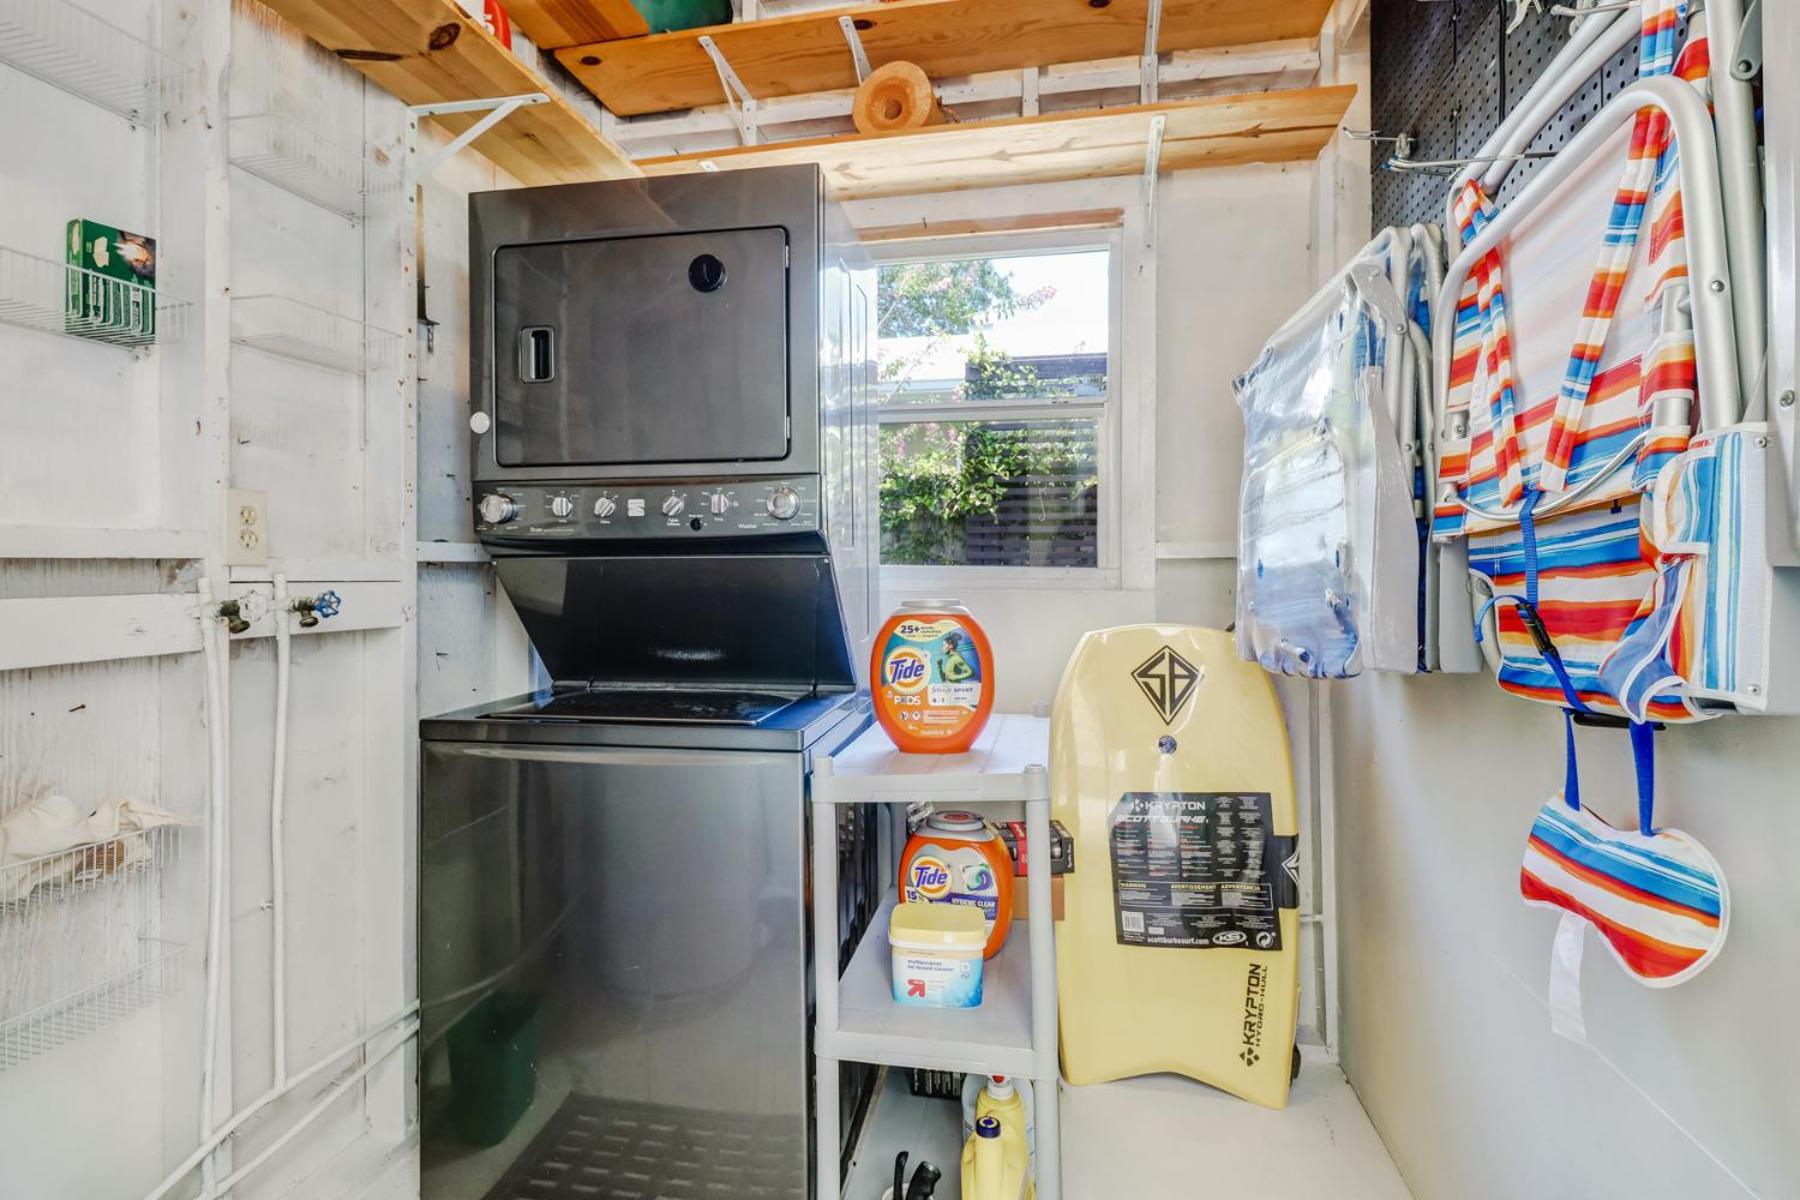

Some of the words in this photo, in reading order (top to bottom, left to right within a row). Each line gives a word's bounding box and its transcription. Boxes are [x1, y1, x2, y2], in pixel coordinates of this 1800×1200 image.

[901, 625, 920, 634] 25+
[890, 659, 925, 684] Tide
[1145, 801, 1206, 811] KRYPTON
[914, 866, 948, 888] Tide
[978, 901, 996, 909] CLEAN
[1243, 963, 1261, 1046] KRYPTON
